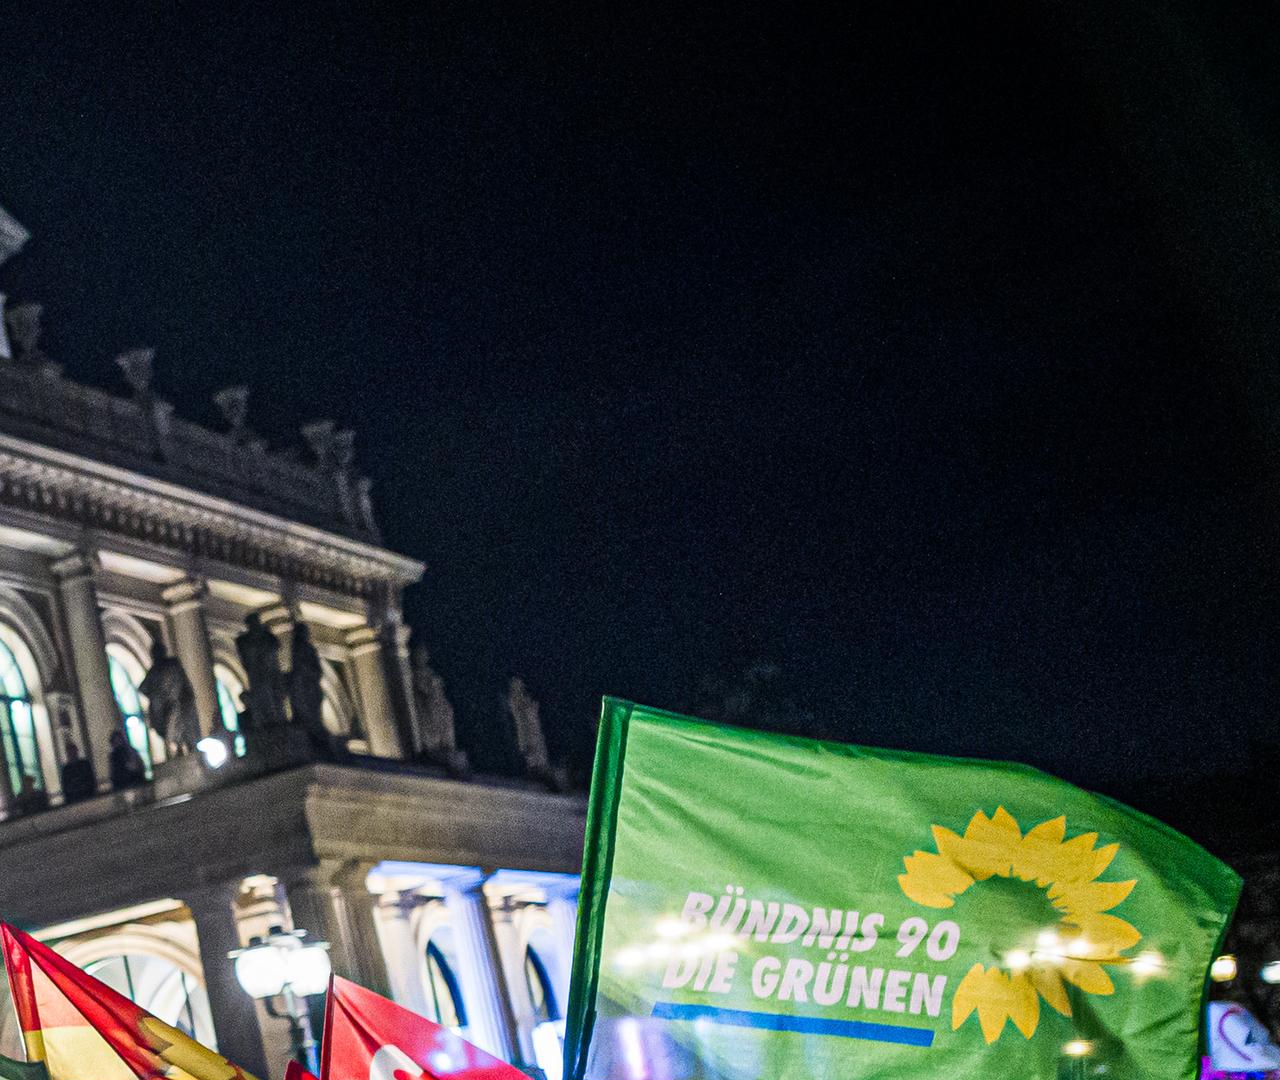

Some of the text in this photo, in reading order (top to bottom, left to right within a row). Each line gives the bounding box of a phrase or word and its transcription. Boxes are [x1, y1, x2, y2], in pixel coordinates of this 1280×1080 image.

[680, 885, 961, 962] BÜNDNIS 90
[662, 950, 947, 1018] DIE GRÜNEN
